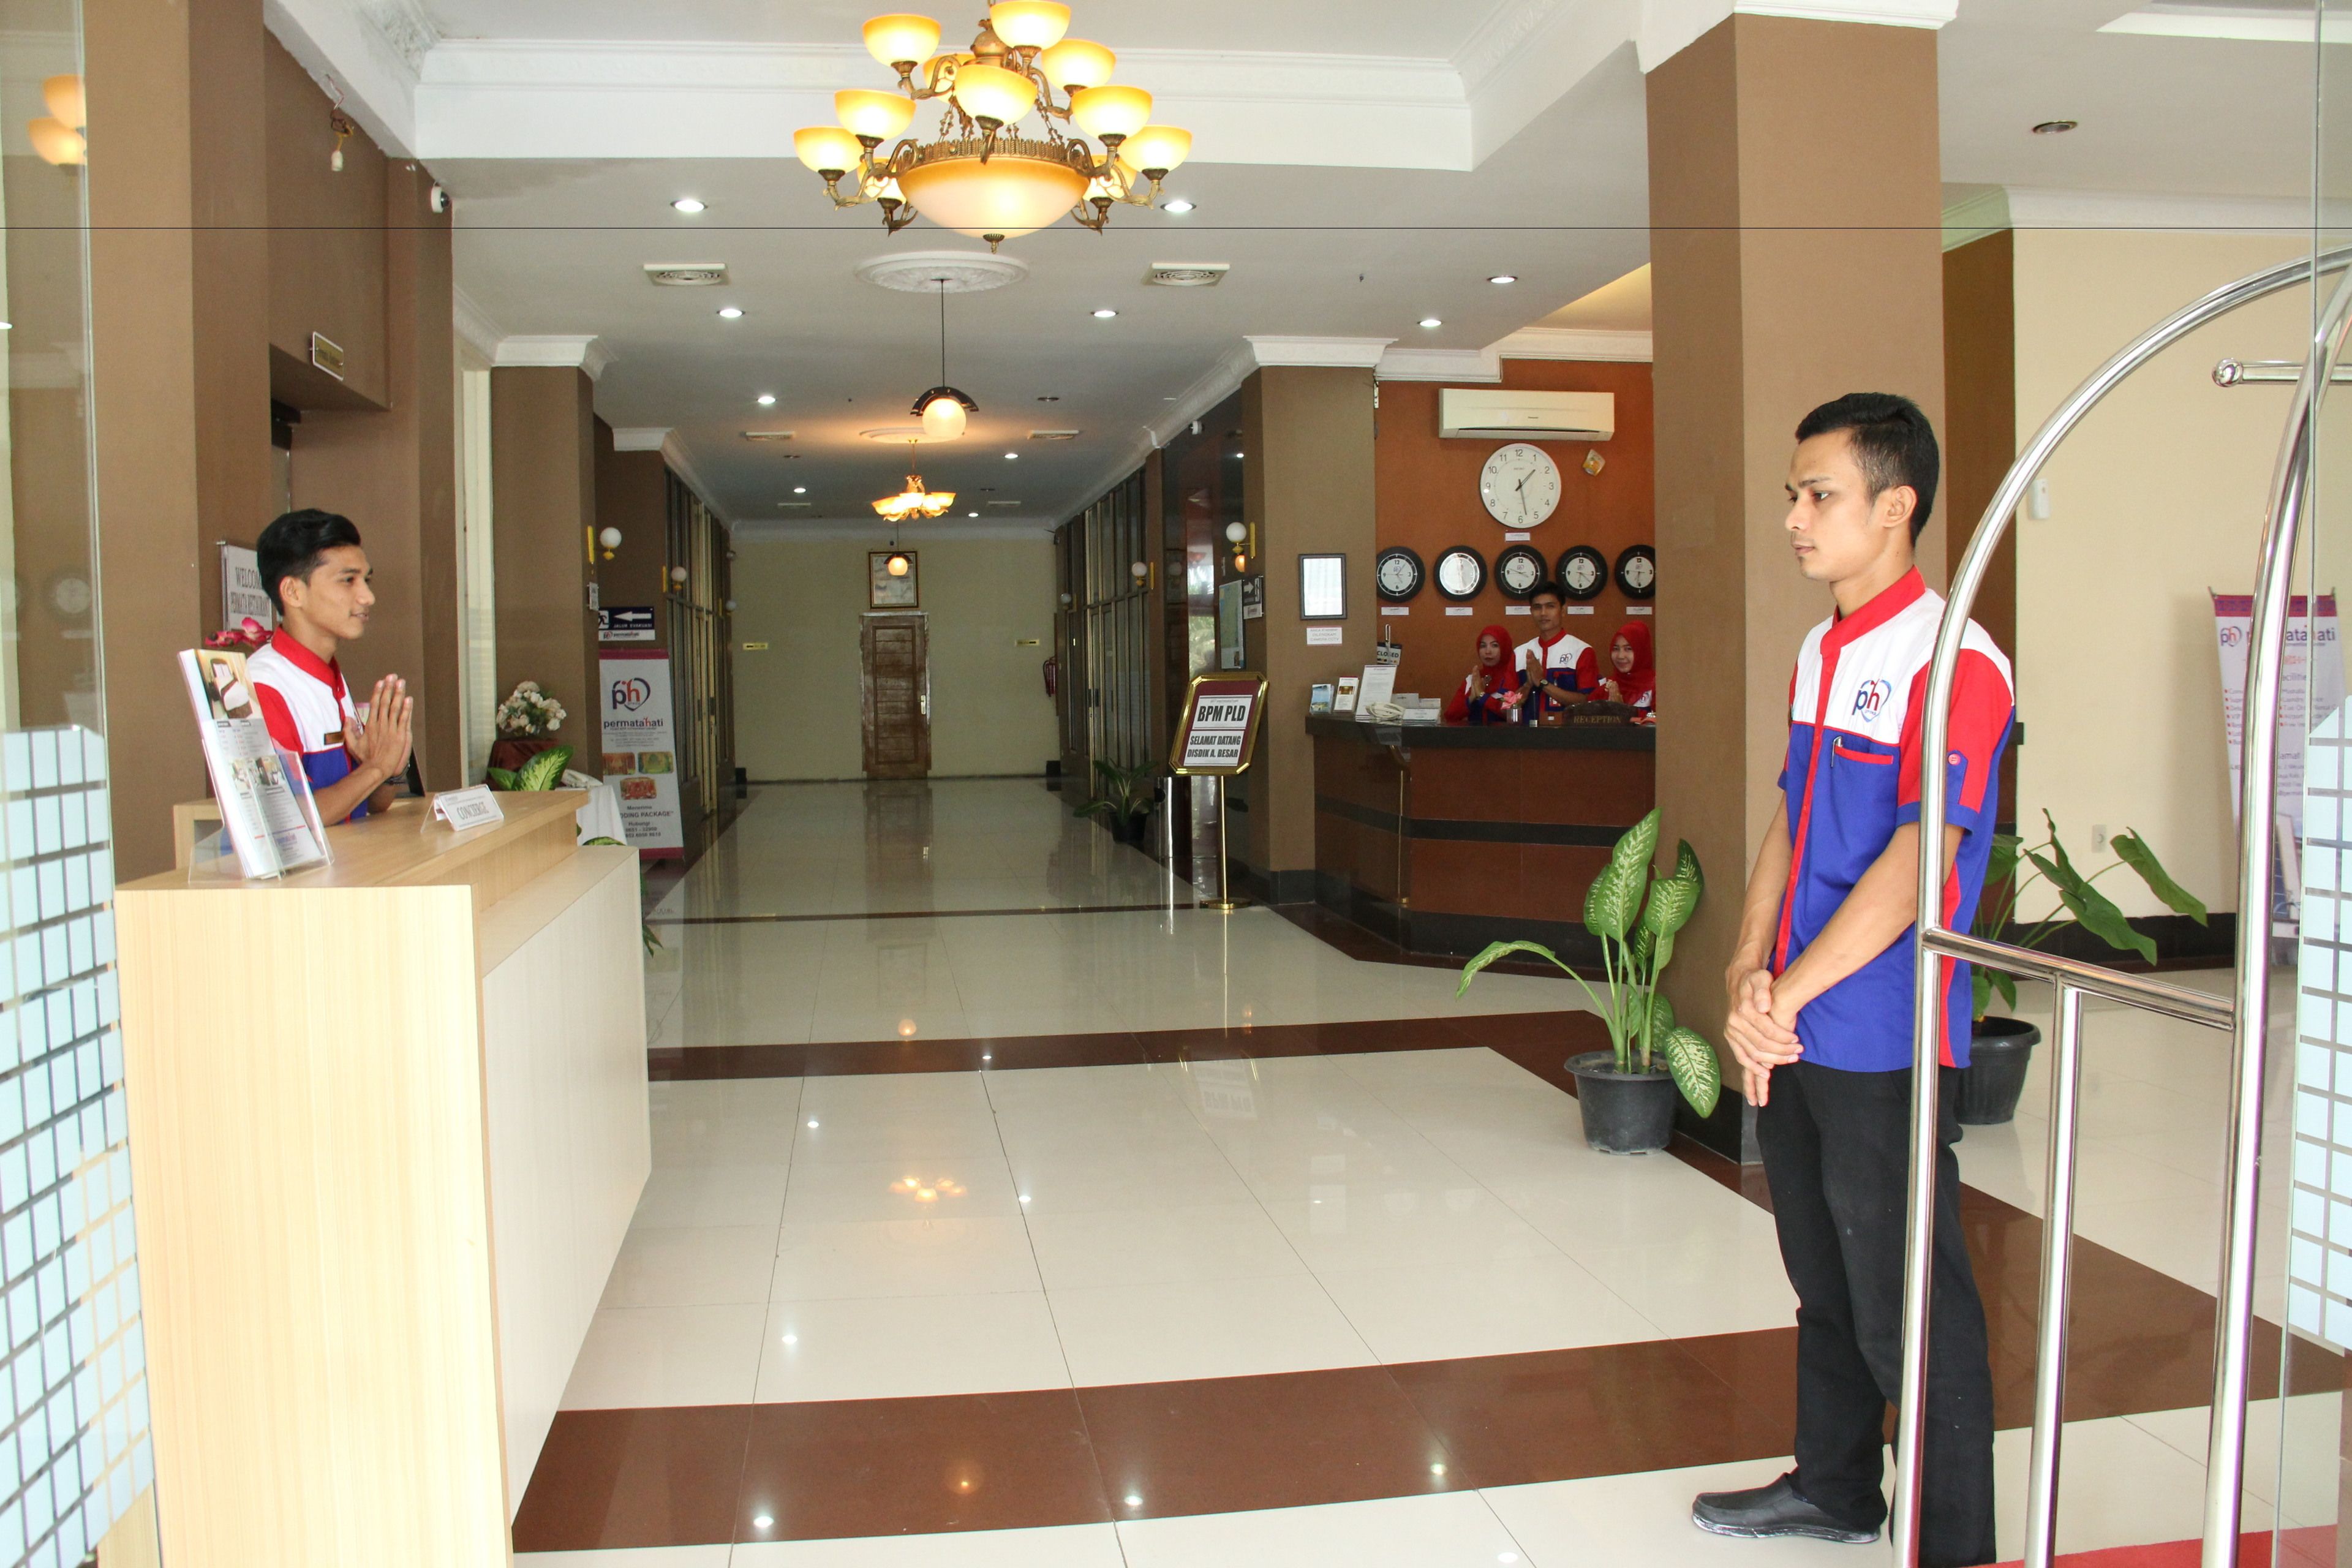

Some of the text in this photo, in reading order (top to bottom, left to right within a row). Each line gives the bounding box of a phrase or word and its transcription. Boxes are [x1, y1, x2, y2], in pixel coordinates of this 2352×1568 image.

[236, 567, 262, 590] WELCOM
[612, 679, 640, 709] ph
[1852, 679, 1880, 715] ph
[1197, 706, 1246, 722] BPM PLD
[604, 717, 663, 729] permatahati
[1190, 736, 1241, 745] SELAMAT DATANG
[1187, 749, 1238, 758] DISDIK A. BESAR
